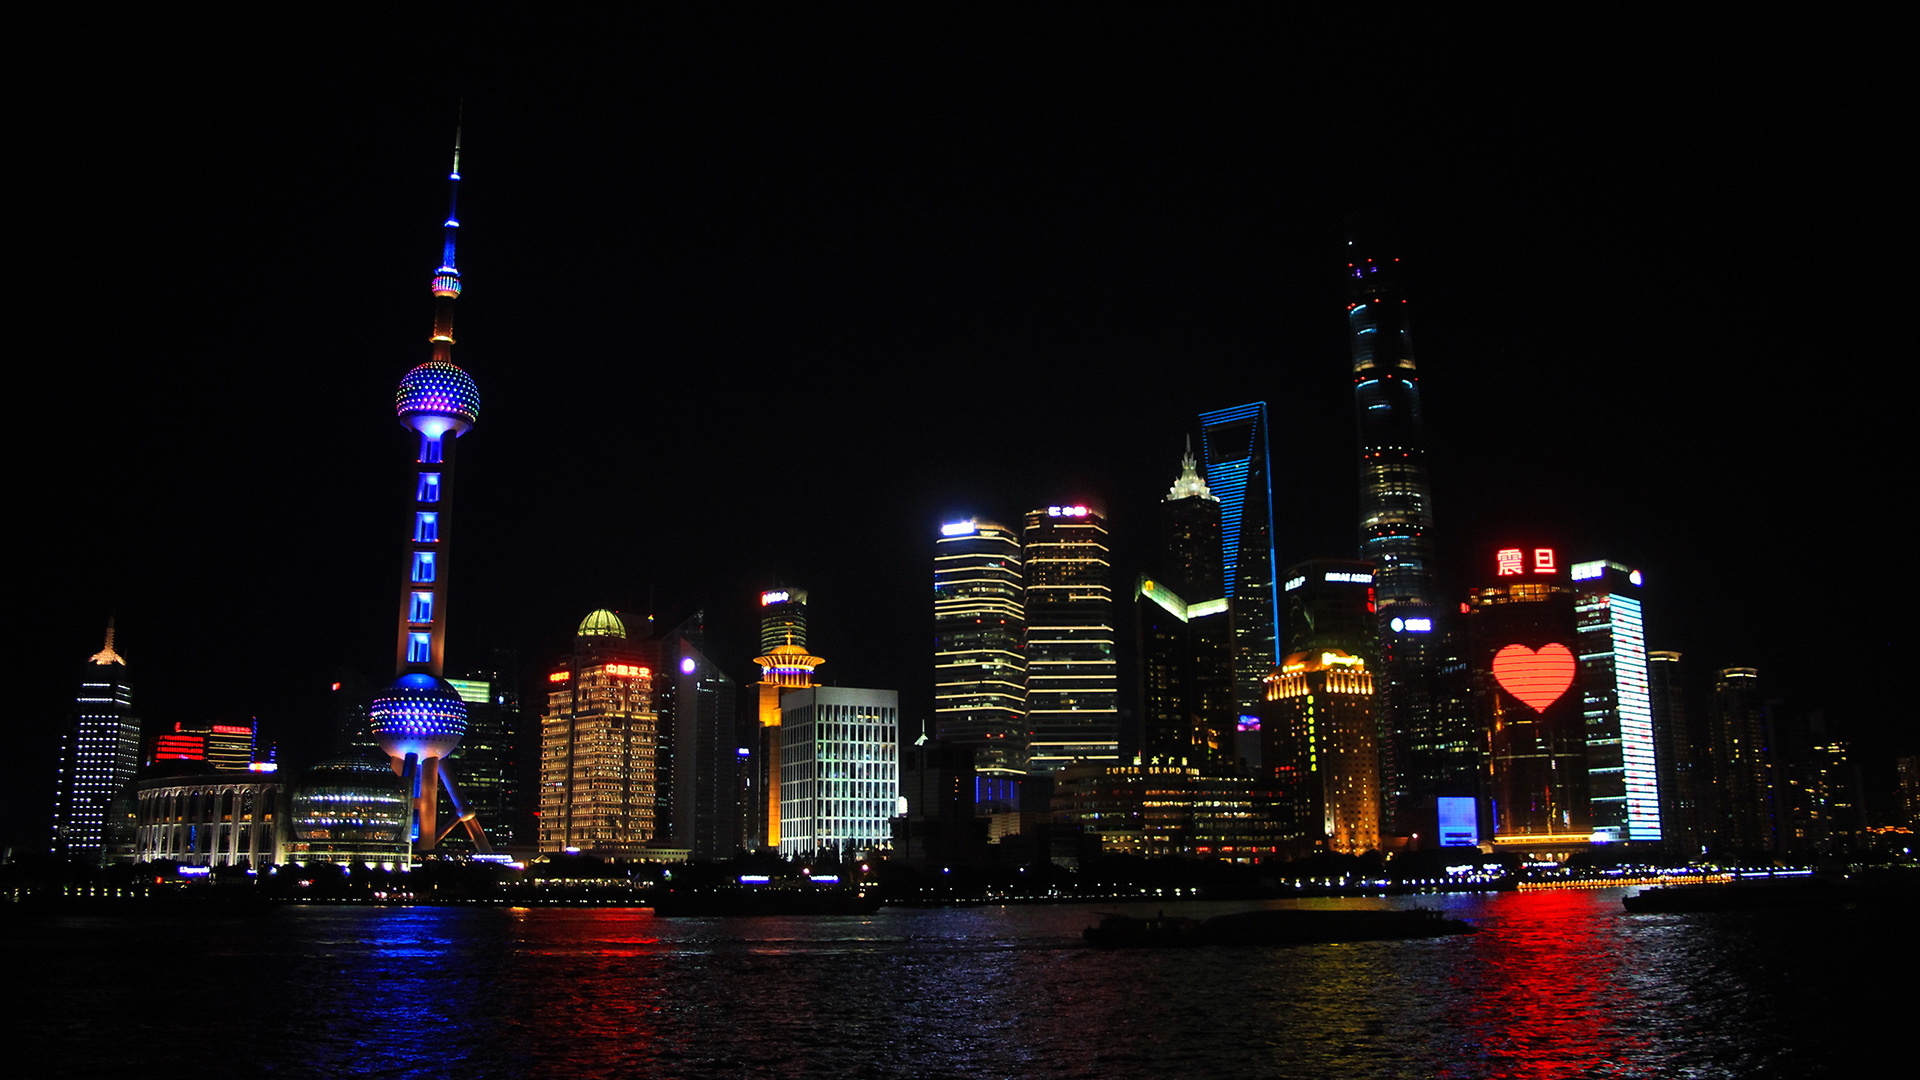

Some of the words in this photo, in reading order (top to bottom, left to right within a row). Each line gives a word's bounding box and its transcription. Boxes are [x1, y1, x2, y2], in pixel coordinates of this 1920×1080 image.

[1497, 548, 1557, 576] 震旦
[1351, 573, 1373, 583] ASSET
[605, 664, 650, 678] 中国平安
